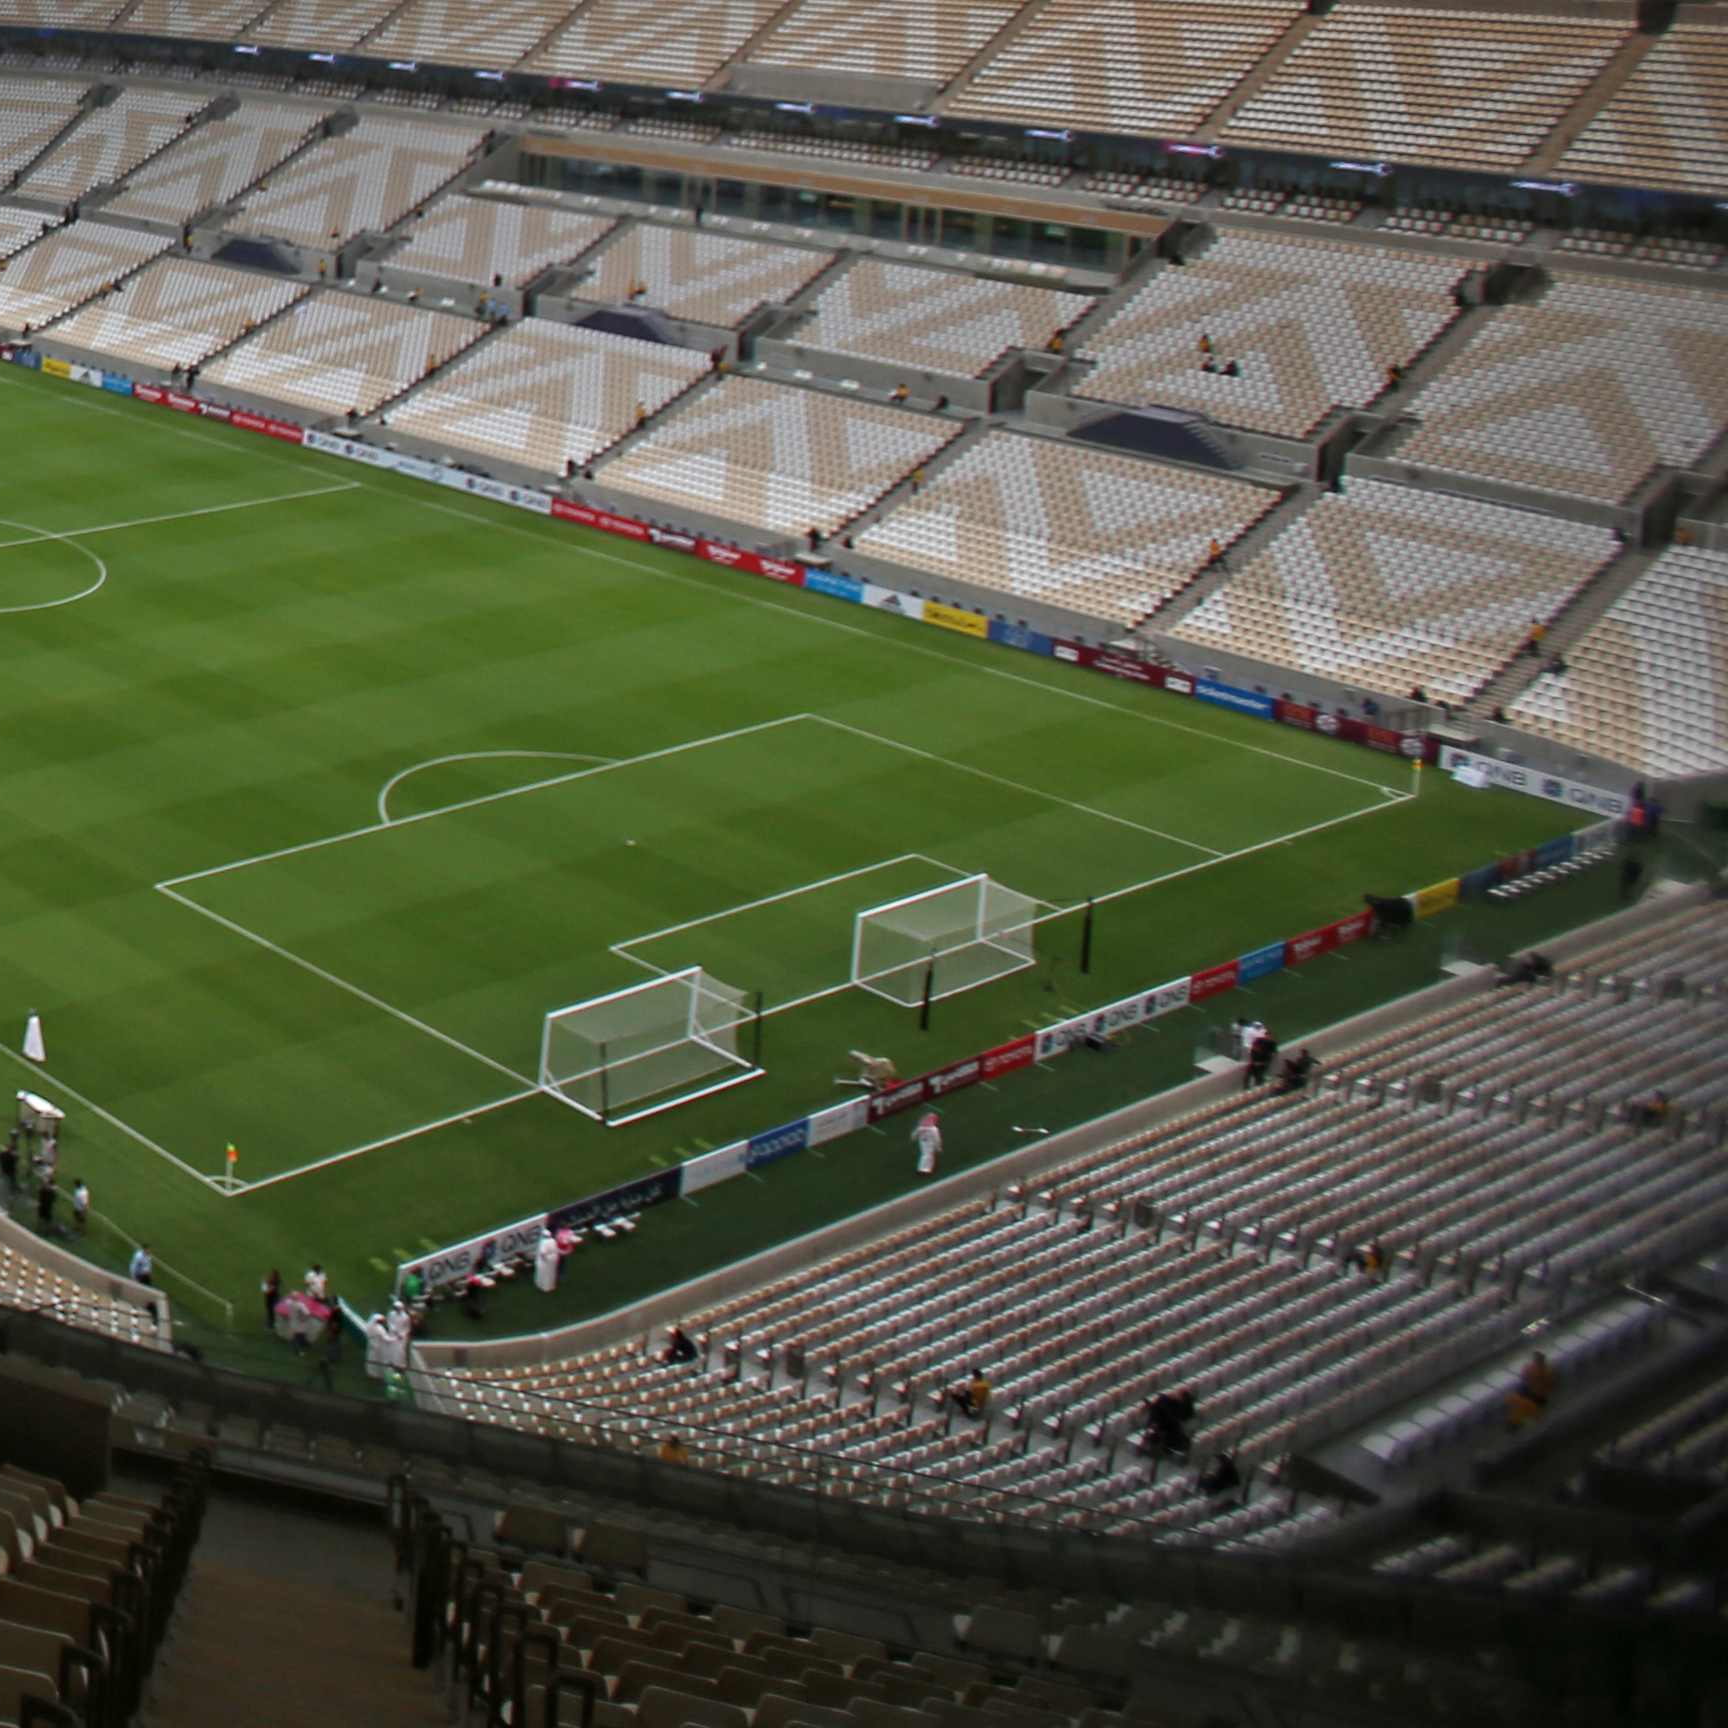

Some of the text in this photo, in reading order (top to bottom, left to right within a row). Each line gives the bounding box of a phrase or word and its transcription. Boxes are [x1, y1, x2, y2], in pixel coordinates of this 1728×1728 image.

[1476, 761, 1623, 813] QNB QNB
[1105, 1003, 1139, 1027] QNB
[1158, 984, 1189, 1008] QNB
[429, 1224, 542, 1280] QNB QNB
